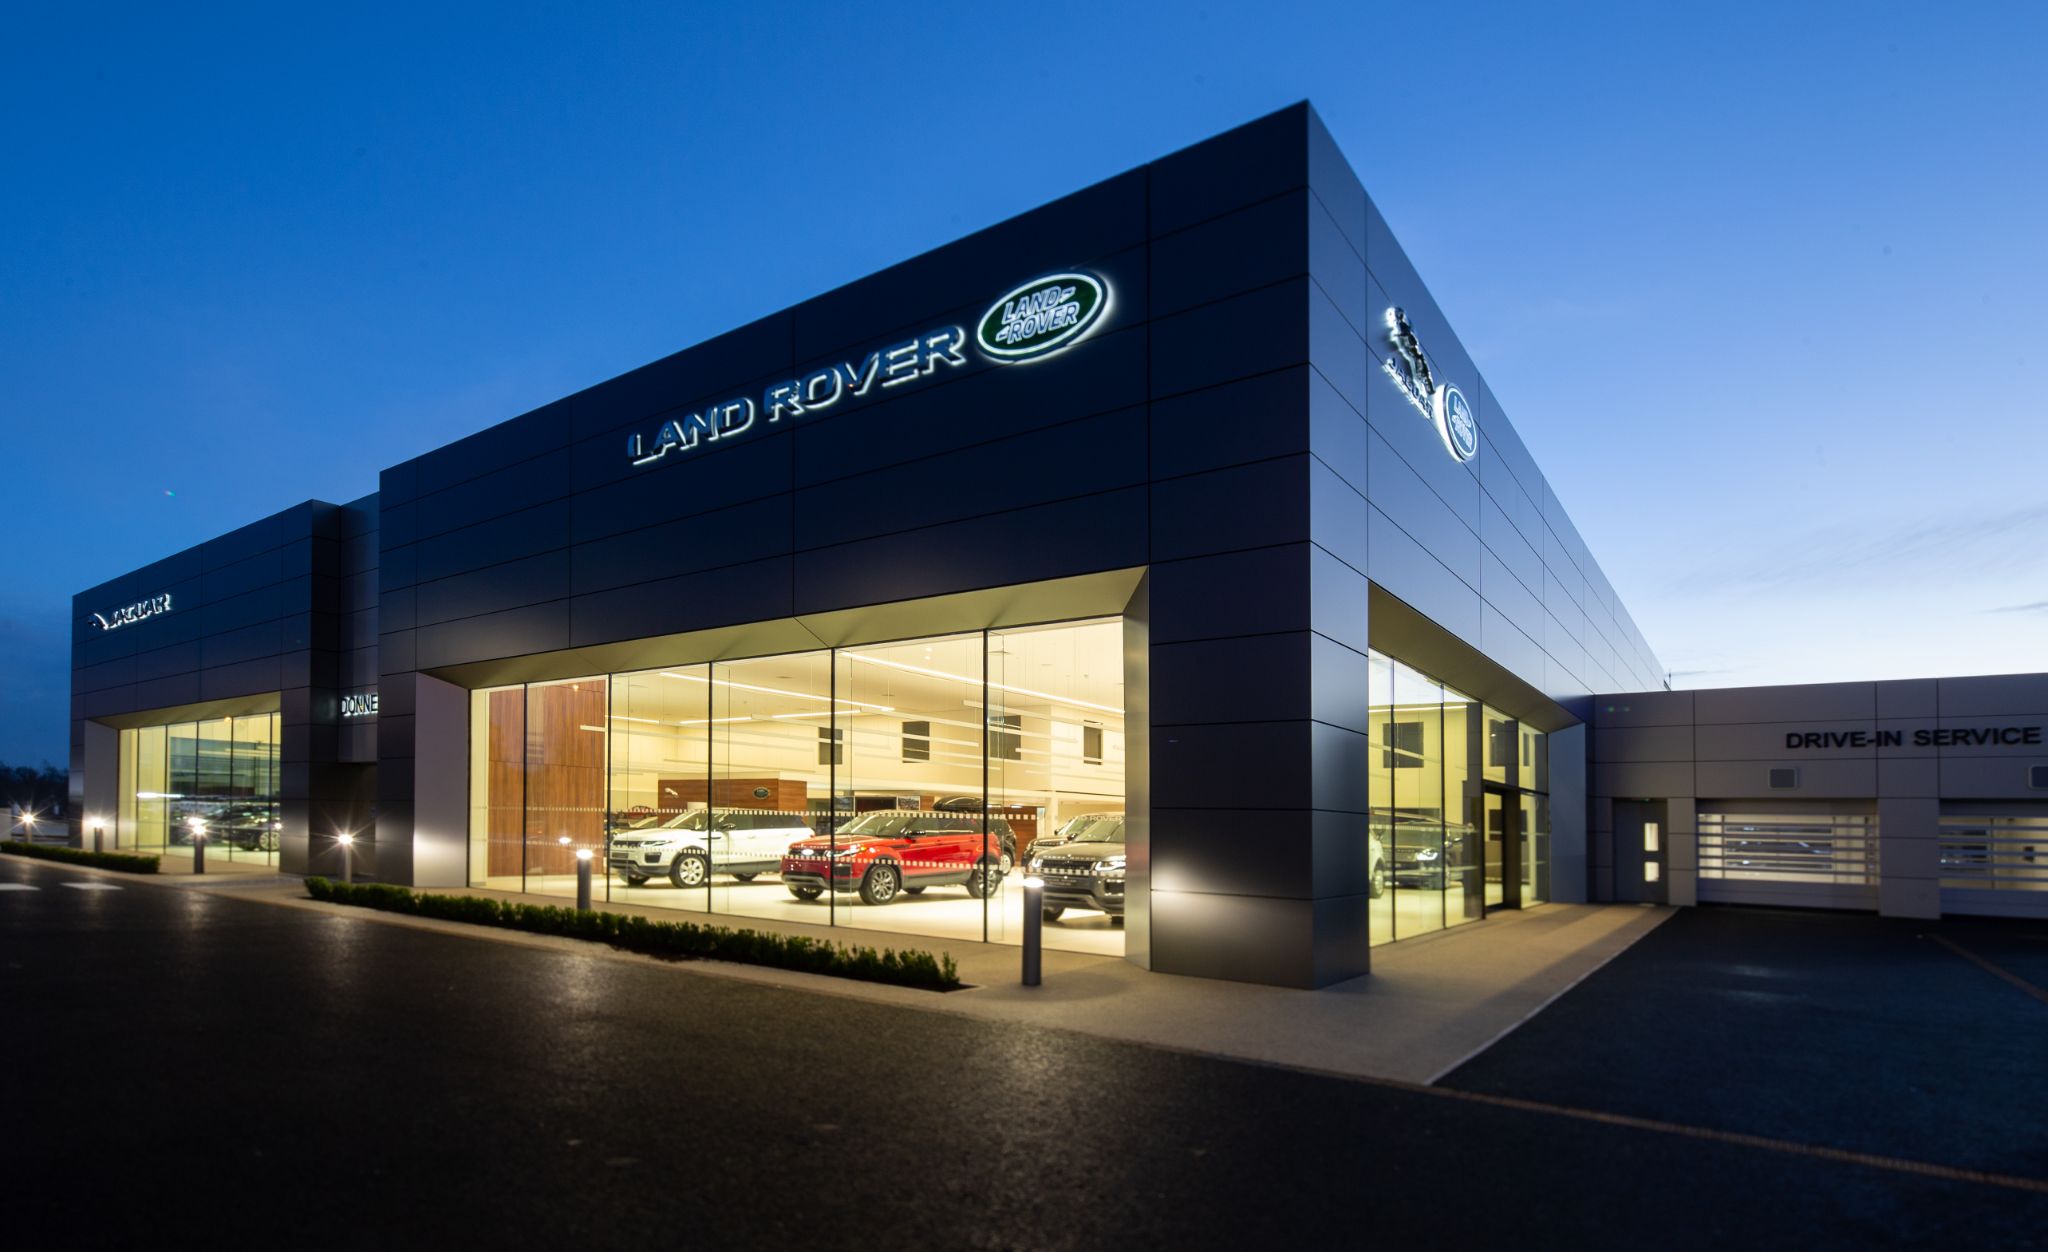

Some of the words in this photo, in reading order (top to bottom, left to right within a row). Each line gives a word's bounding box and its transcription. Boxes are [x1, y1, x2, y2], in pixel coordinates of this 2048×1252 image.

[1001, 286, 1063, 325] LAND
[1006, 301, 1080, 344] ROVER
[627, 397, 754, 466] LAND
[764, 325, 966, 422] ROVER
[1786, 730, 1902, 749] DRIVE-IN
[1914, 726, 2043, 747] SERVICE
